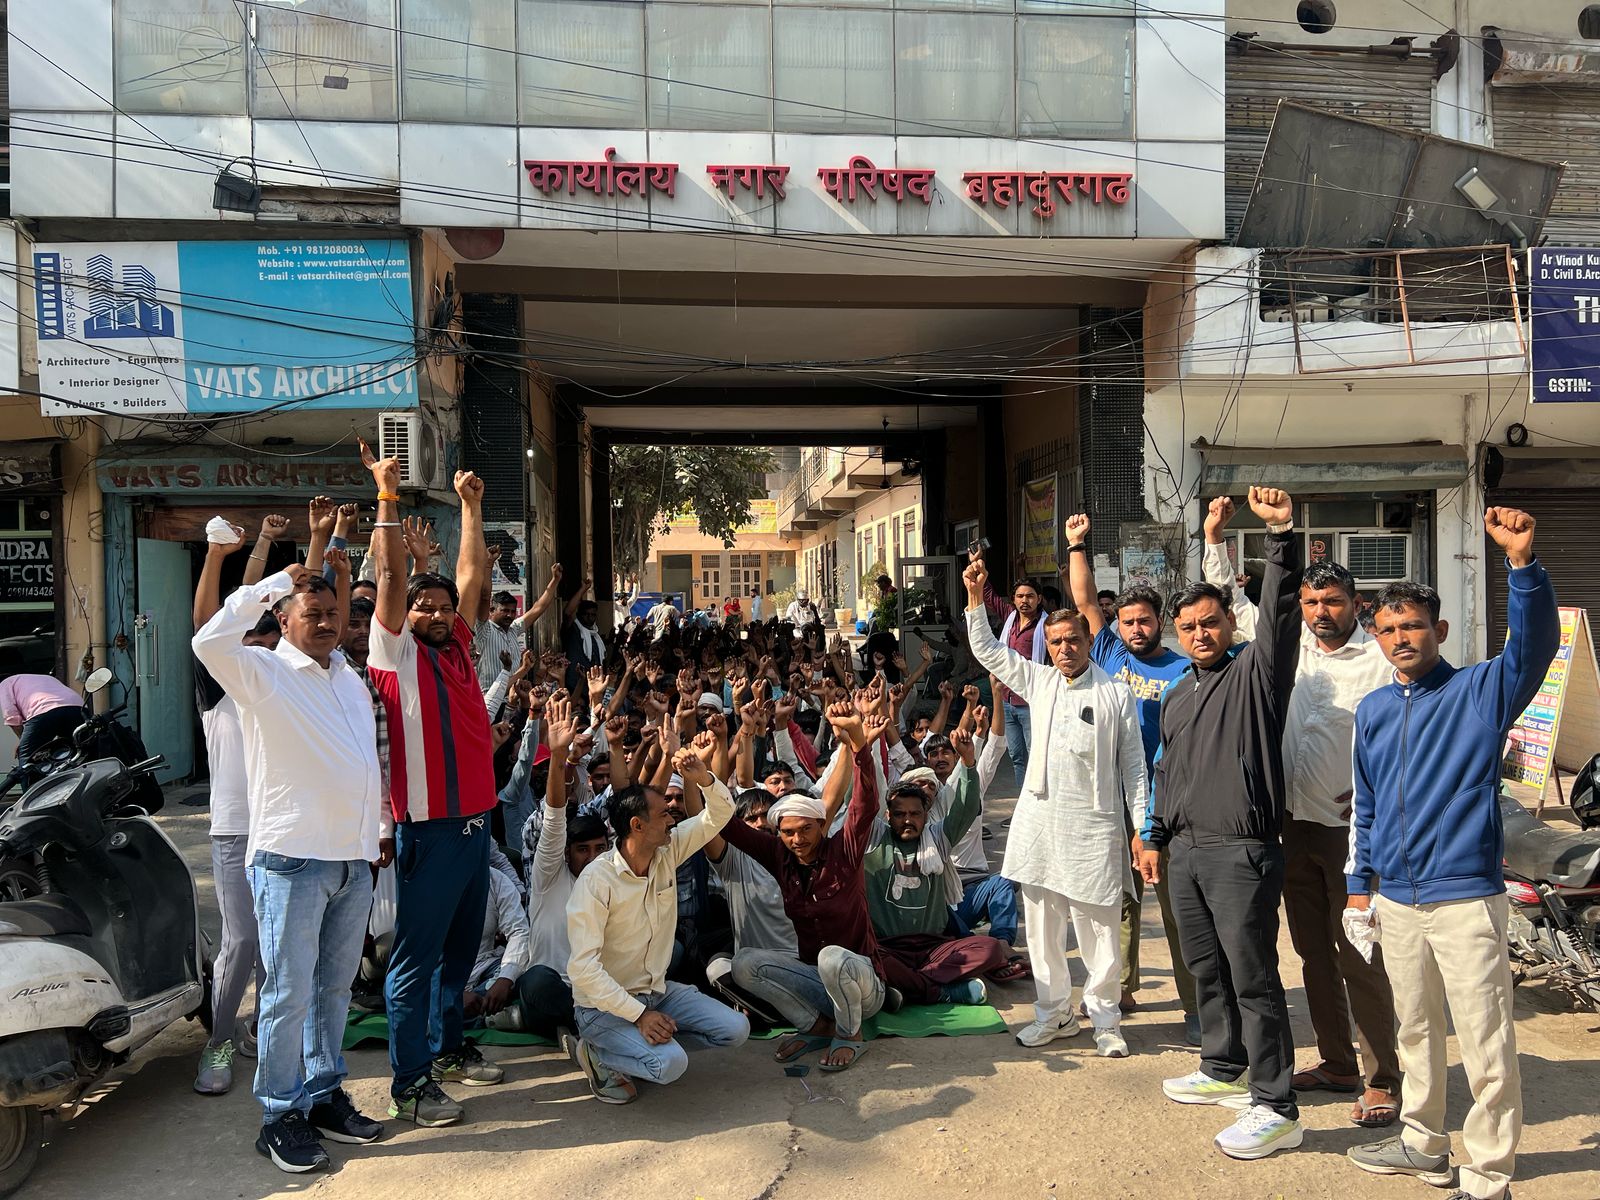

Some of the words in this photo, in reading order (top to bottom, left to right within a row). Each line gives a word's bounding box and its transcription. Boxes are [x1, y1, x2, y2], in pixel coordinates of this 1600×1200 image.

[524, 147, 679, 198] कार्यालय
[706, 165, 790, 200] नगर
[816, 155, 936, 204] परिषद
[962, 170, 1133, 218] बहादुरगढ
[257, 246, 281, 255] Mob.
[284, 246, 303, 255] +91
[306, 245, 365, 255] 9812080036
[258, 259, 295, 268] Website
[303, 258, 405, 268] www.vatsarchitect.com
[1541, 253, 1553, 265] Ar
[1555, 254, 1583, 266] Vinod
[259, 271, 289, 281] E-mail
[297, 270, 410, 282] vatsarchitect@gmail.com
[1541, 268, 1551, 280] D.
[1553, 268, 1573, 280] Civil
[63, 256, 76, 310] ARCHITECT
[66, 312, 77, 336] VATS
[46, 357, 110, 366] Architecture
[127, 355, 180, 366] Engineers
[69, 378, 110, 388] Interior
[113, 377, 160, 388] Designer
[194, 366, 263, 399] VATS
[272, 363, 416, 398] ARCHITECT
[1548, 377, 1592, 393] GSTIN:
[123, 398, 167, 407] Builders
[108, 464, 202, 489] VATS
[216, 463, 366, 488] ARCHITEC
[1549, 671, 1564, 682] NOC
[1518, 766, 1544, 785] SERVICE
[12, 981, 71, 1000] Activa
